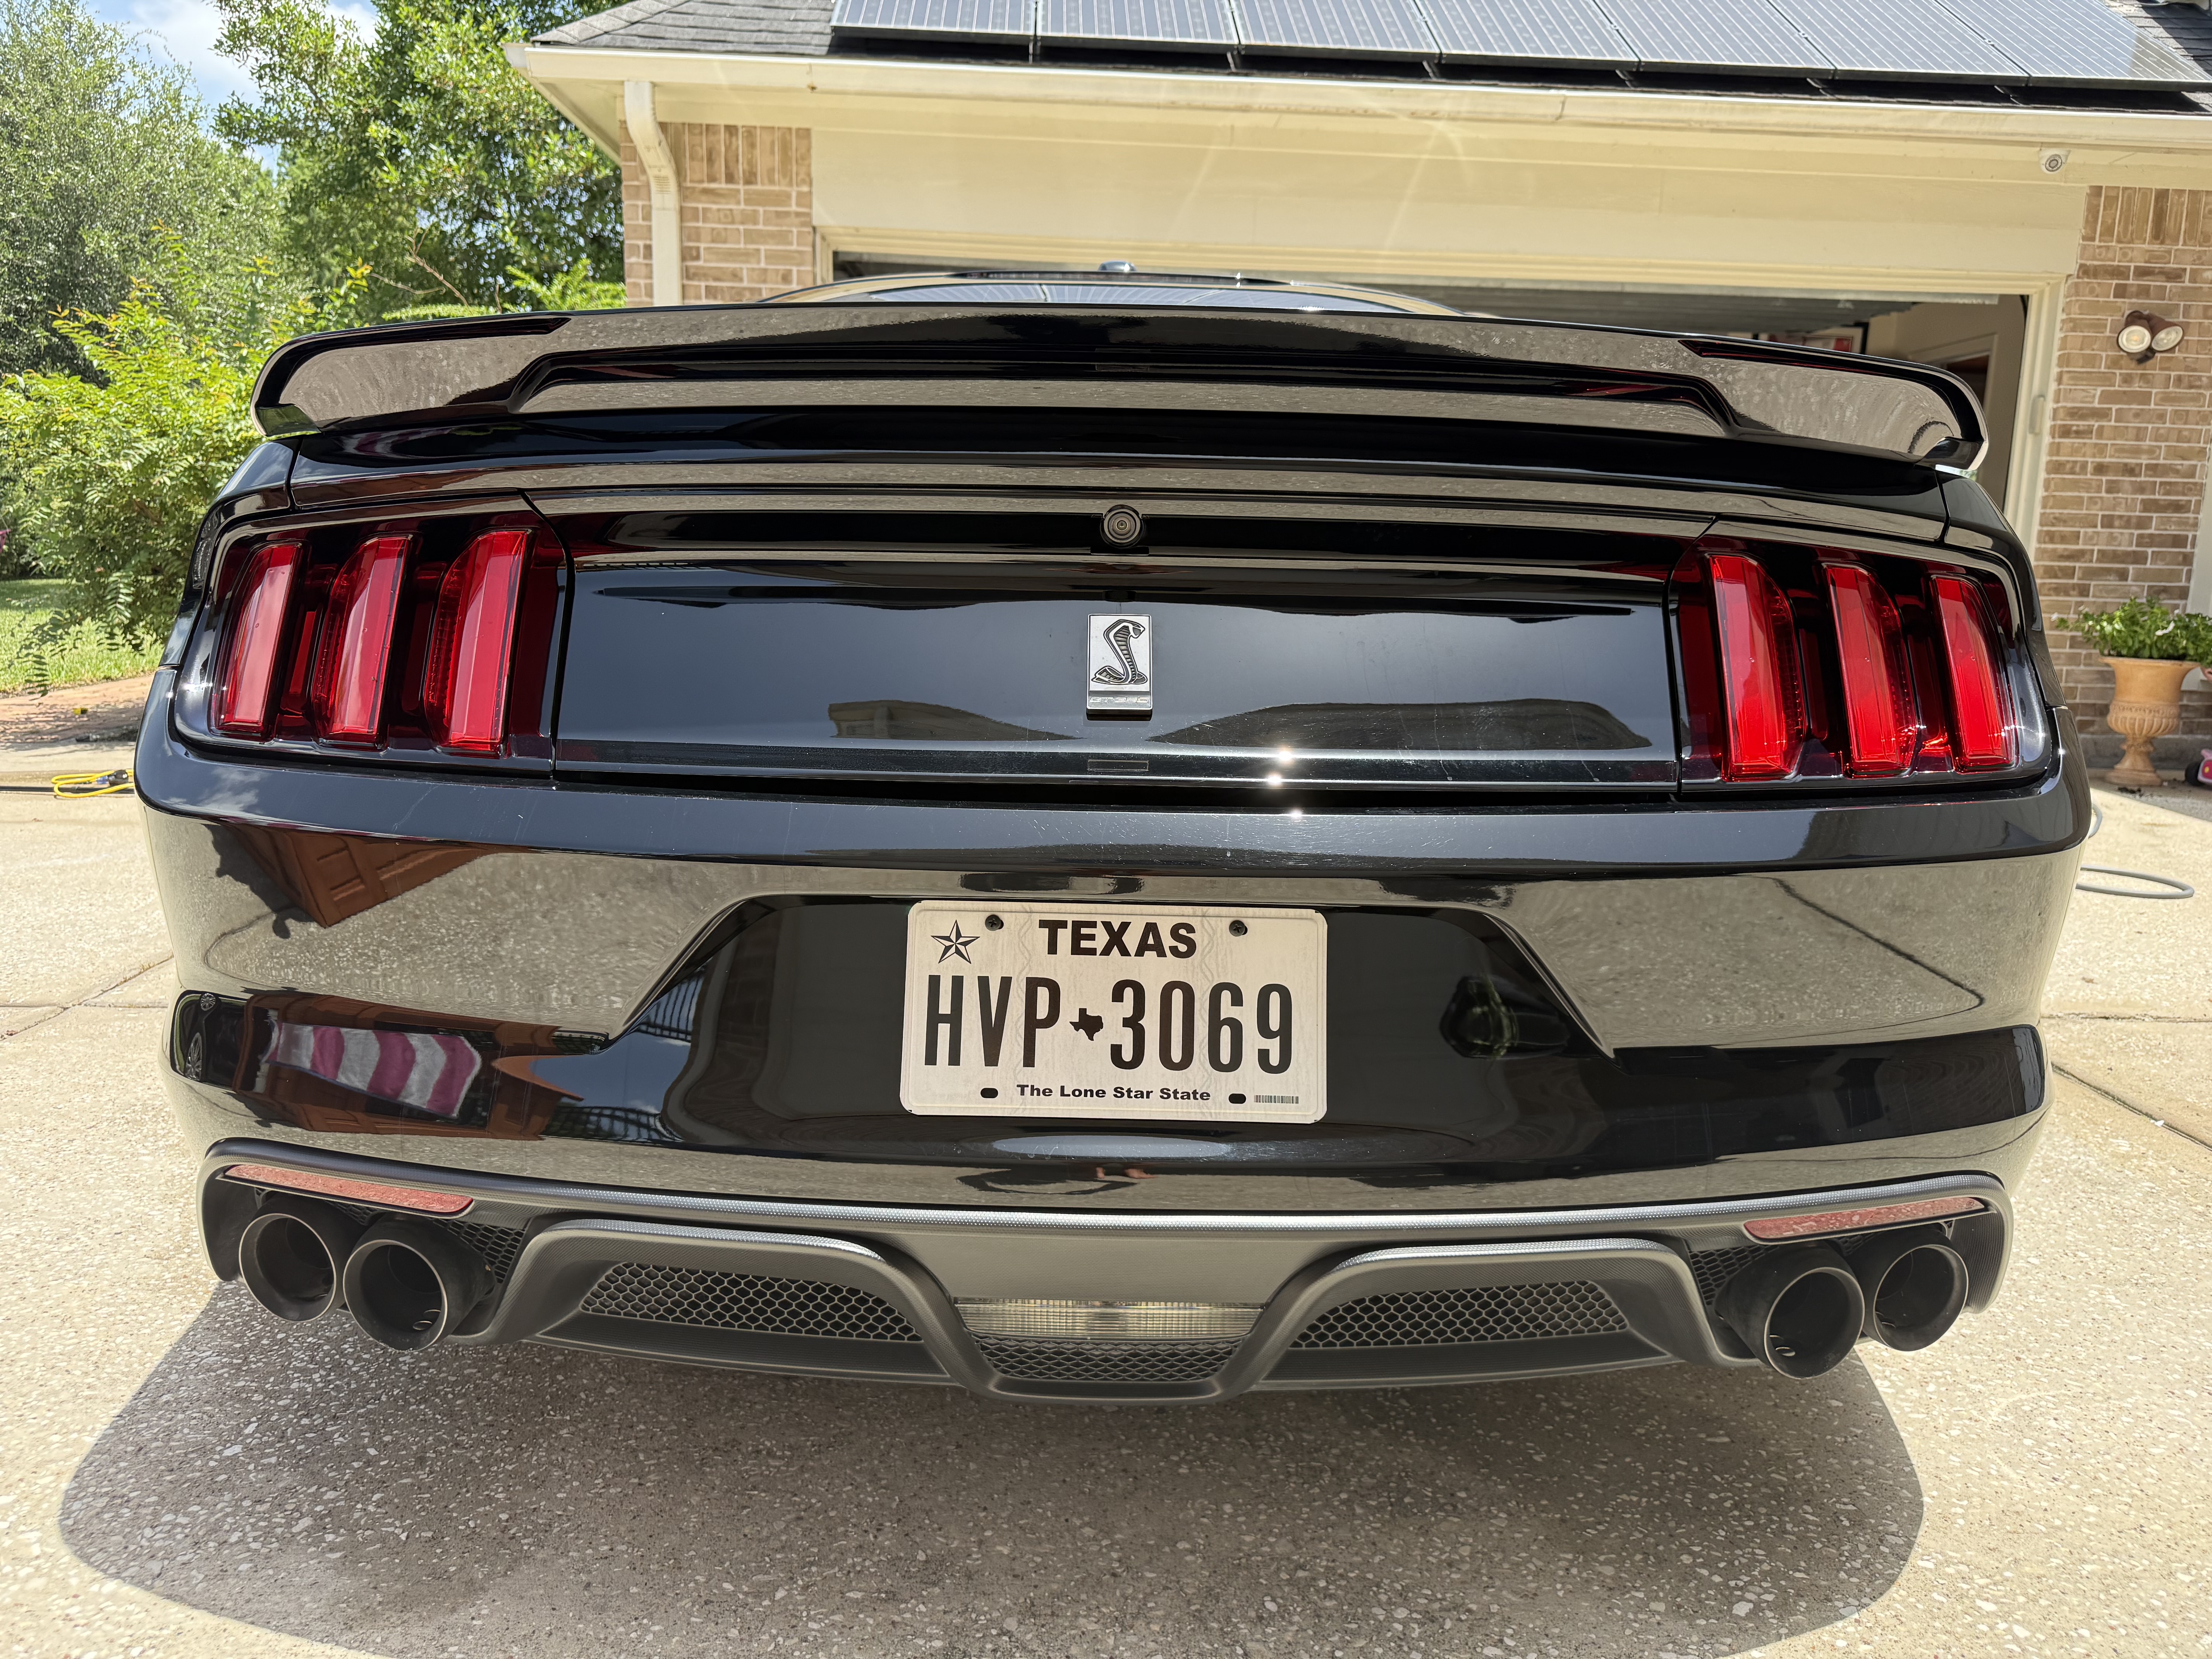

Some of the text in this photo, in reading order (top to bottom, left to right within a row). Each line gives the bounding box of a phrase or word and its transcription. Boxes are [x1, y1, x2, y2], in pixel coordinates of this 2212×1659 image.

[1039, 919, 1197, 959] TEXAS
[924, 975, 1292, 1074] HVP 3069
[1017, 1084, 1211, 1101] The Lone Star State
